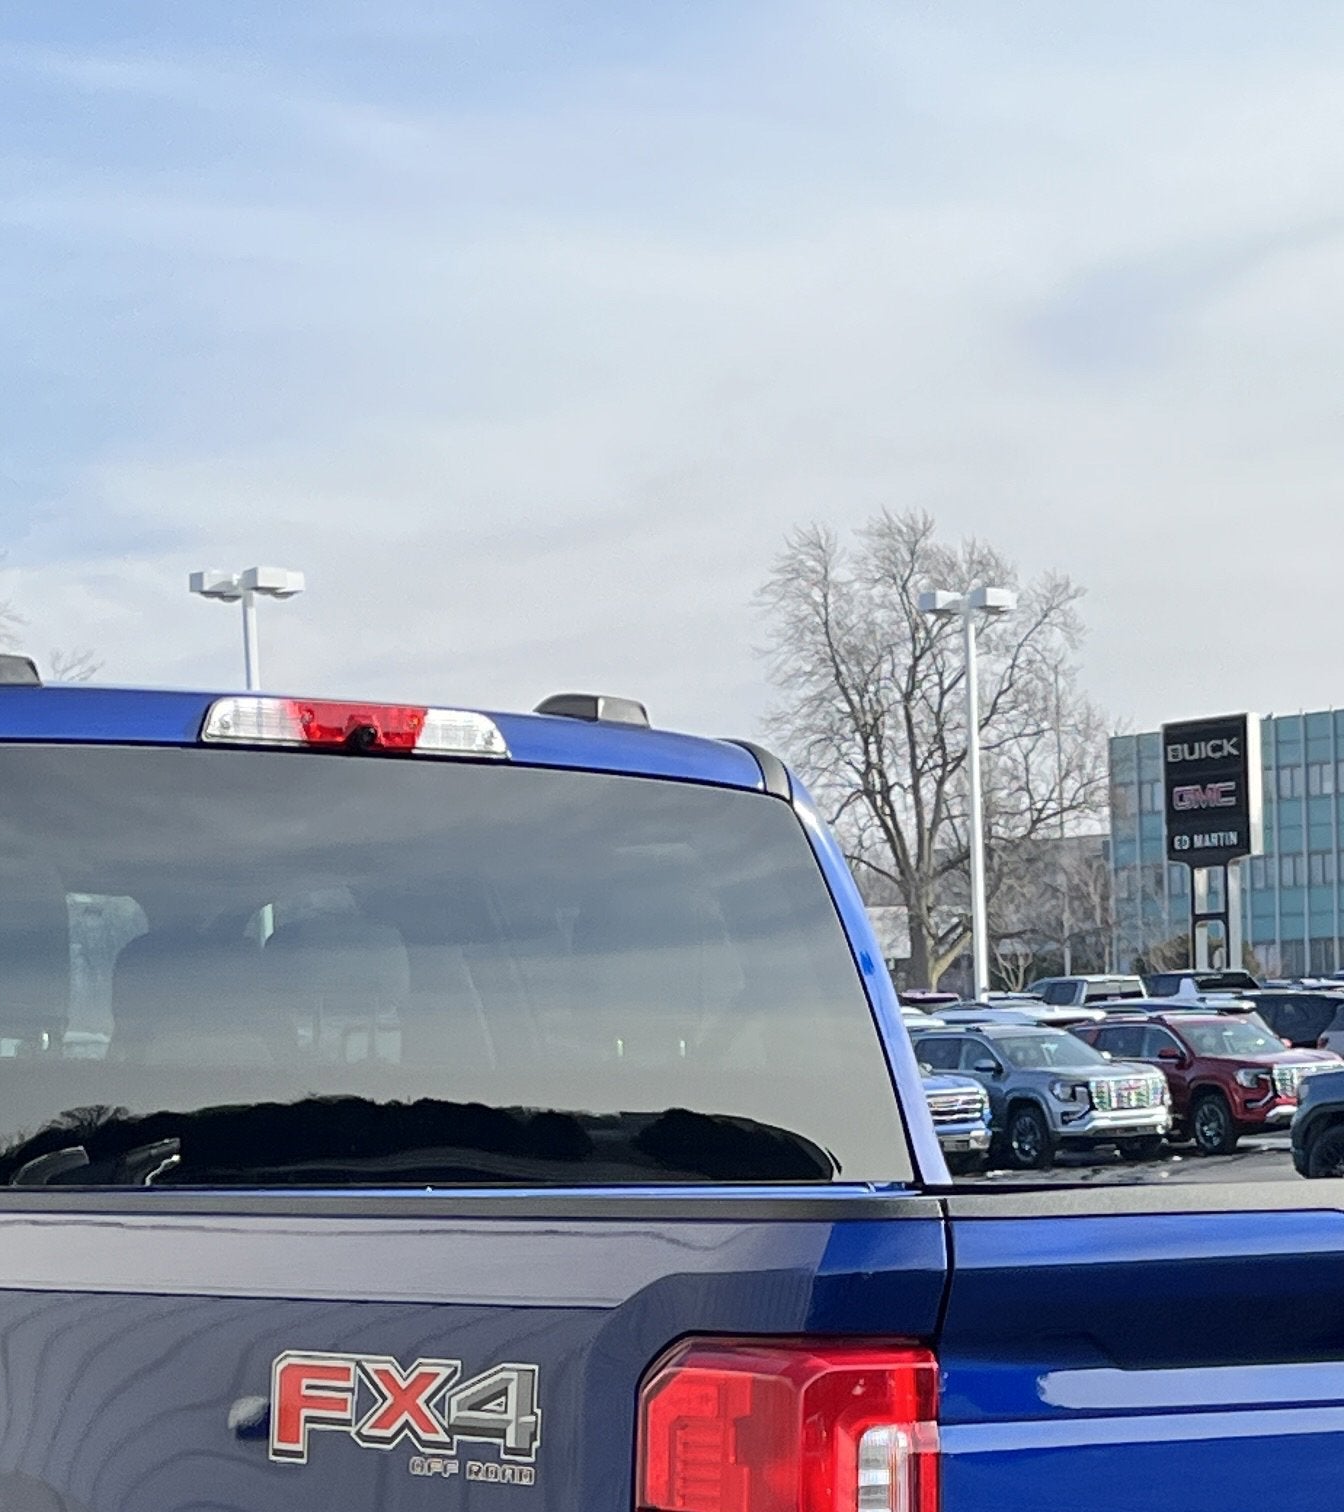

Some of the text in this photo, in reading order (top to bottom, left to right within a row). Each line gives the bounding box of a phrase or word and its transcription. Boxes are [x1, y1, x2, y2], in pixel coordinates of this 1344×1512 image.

[1167, 737, 1240, 763] BUICK
[1172, 782, 1237, 811] GMC
[1174, 831, 1238, 850] ED MARTIN
[268, 1350, 541, 1464] FX4
[409, 1457, 535, 1485] OFF ROAD
